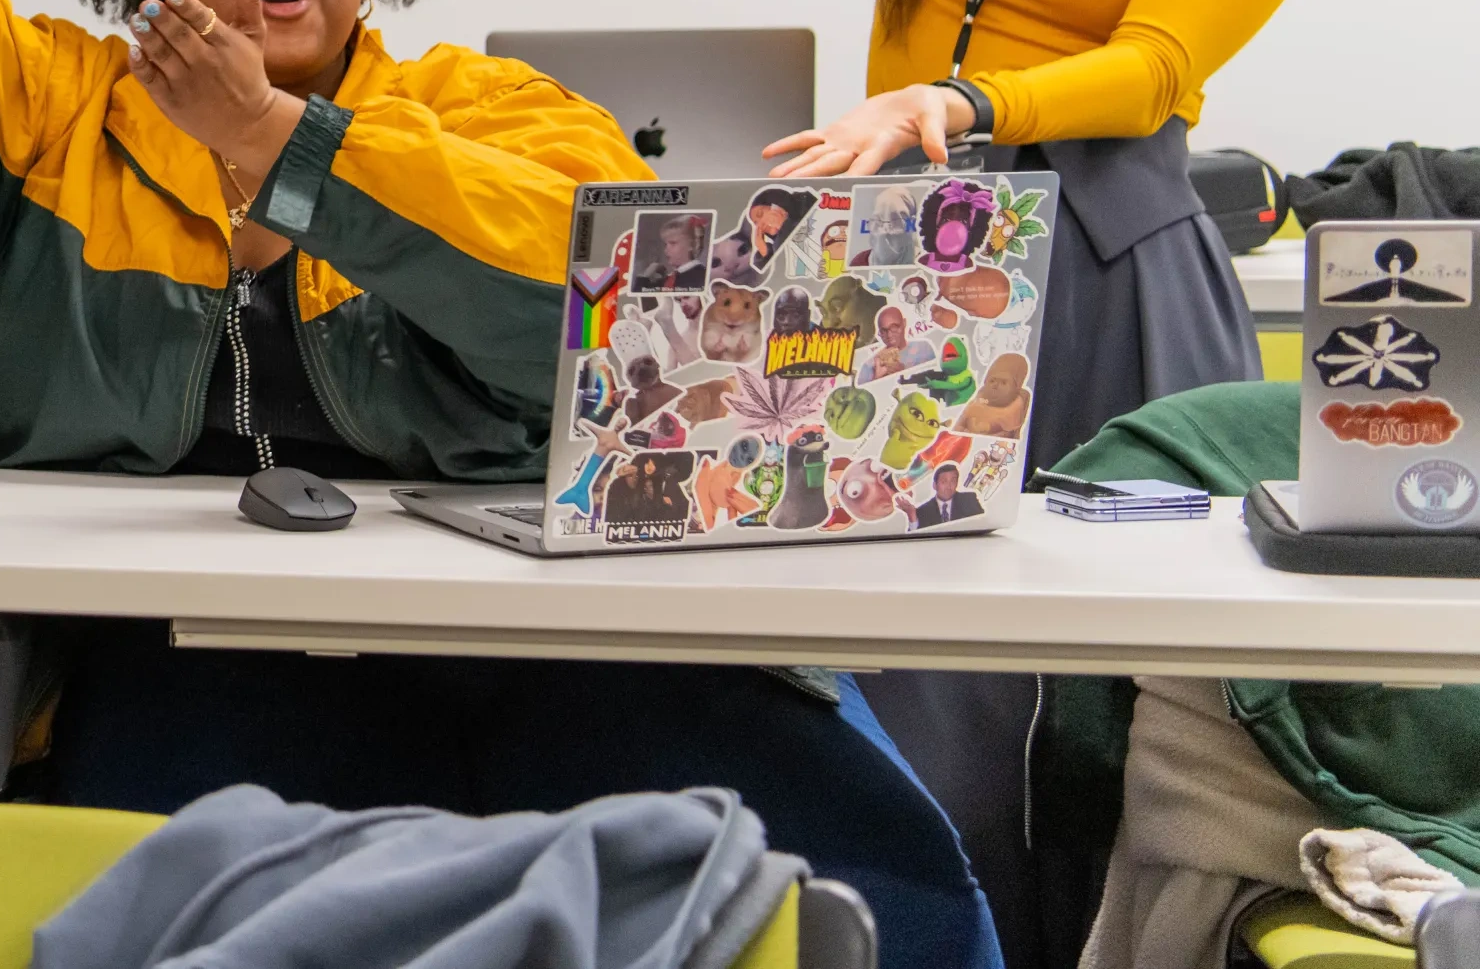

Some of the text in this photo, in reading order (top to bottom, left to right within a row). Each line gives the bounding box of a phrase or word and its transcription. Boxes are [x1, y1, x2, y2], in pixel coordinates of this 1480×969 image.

[576, 215, 590, 259] Lenovo
[766, 327, 857, 376] MELANIN
[1369, 422, 1444, 443] BANGTAN
